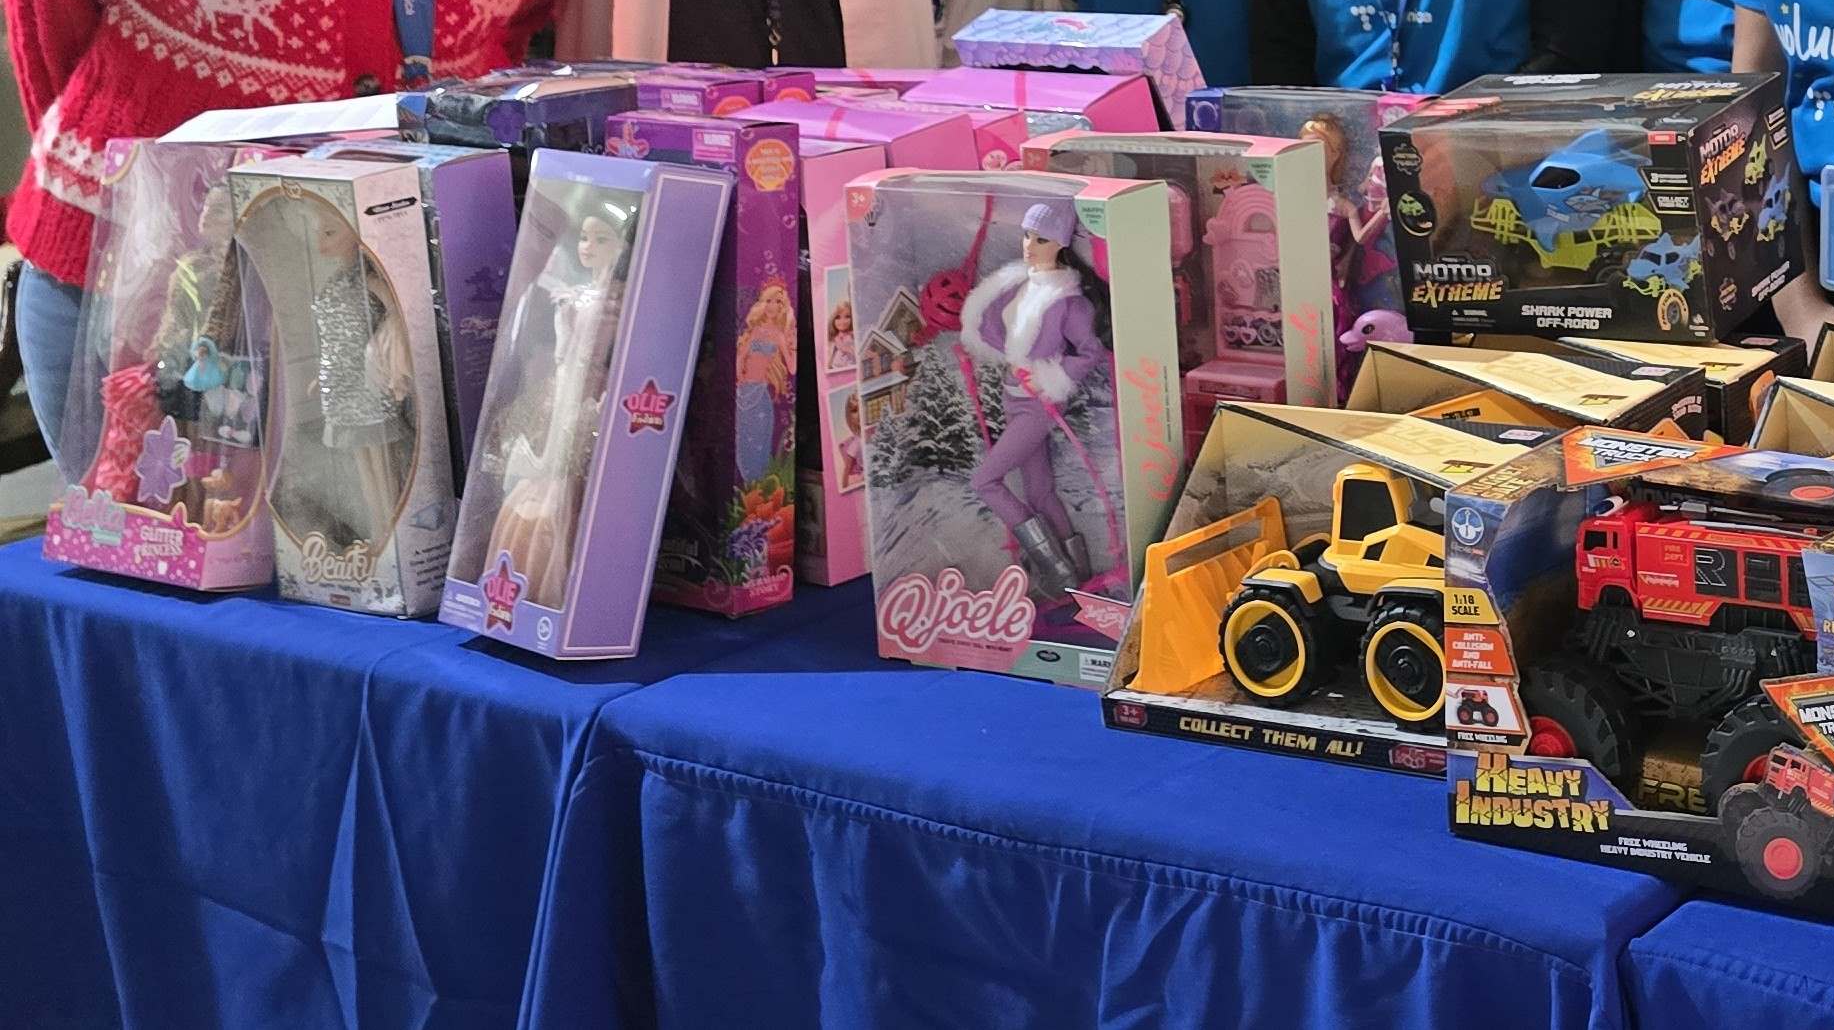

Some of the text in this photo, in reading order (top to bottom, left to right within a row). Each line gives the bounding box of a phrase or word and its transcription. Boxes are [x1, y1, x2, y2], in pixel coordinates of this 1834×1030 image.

[1413, 263, 1492, 282] MOTOR
[1410, 280, 1504, 308] EXTREME
[1521, 305, 1612, 319] SHARK POWER
[1536, 317, 1600, 330] OFF-ROAD
[627, 393, 668, 413] OLIE
[1576, 437, 1698, 459] MONSTER
[1592, 448, 1656, 462] TRUCK
[1451, 605, 1480, 617] SCALE
[1178, 716, 1364, 758] COLLECT THEM ALL!
[1475, 752, 1582, 798] HEAVY
[1455, 779, 1610, 834] INDUSTRY
[1618, 836, 1688, 851] FREE WHEELING
[1599, 844, 1712, 864] HEAVY INDUSTRY VEHICLE
